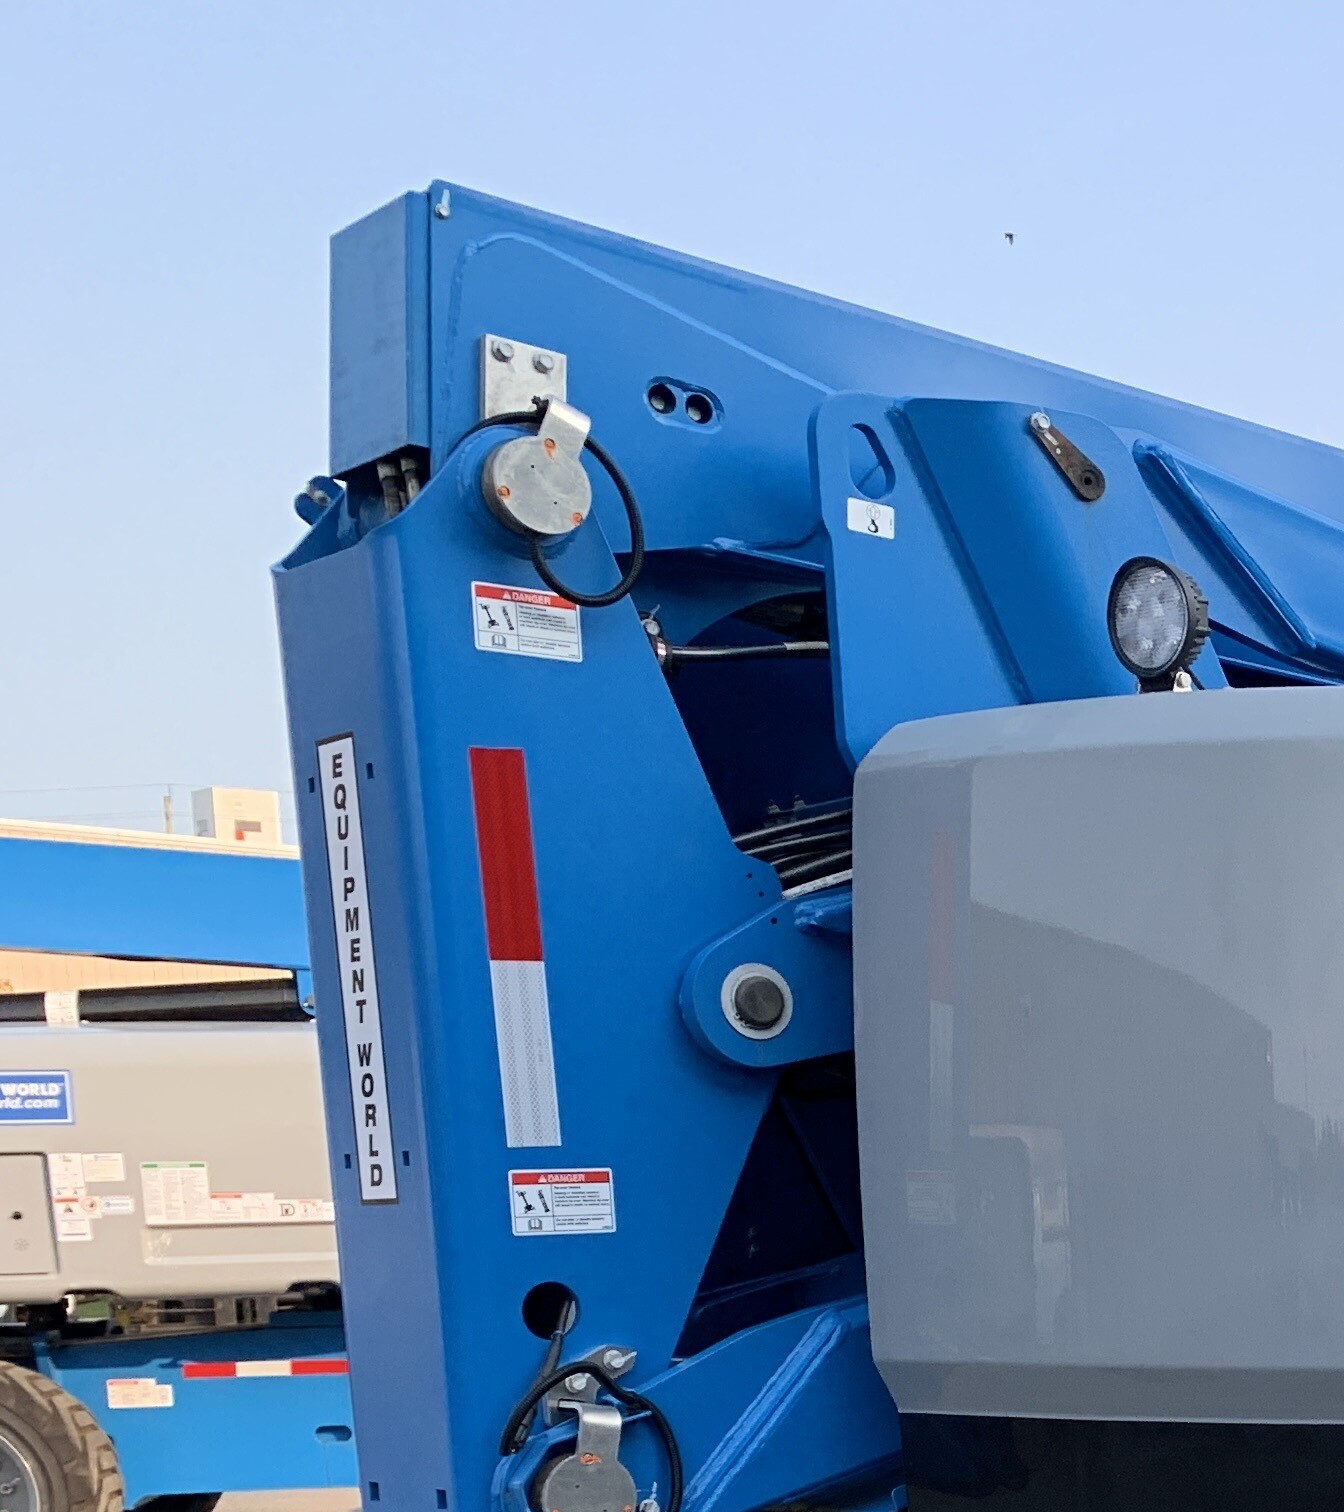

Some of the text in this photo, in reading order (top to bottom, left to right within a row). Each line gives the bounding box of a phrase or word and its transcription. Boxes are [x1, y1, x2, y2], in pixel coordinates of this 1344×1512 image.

[512, 592, 551, 605] DANGER
[332, 752, 383, 1187] EQUIPMENT WORLD
[0, 1083, 60, 1096] WORLD
[547, 1173, 586, 1183] DANGER
